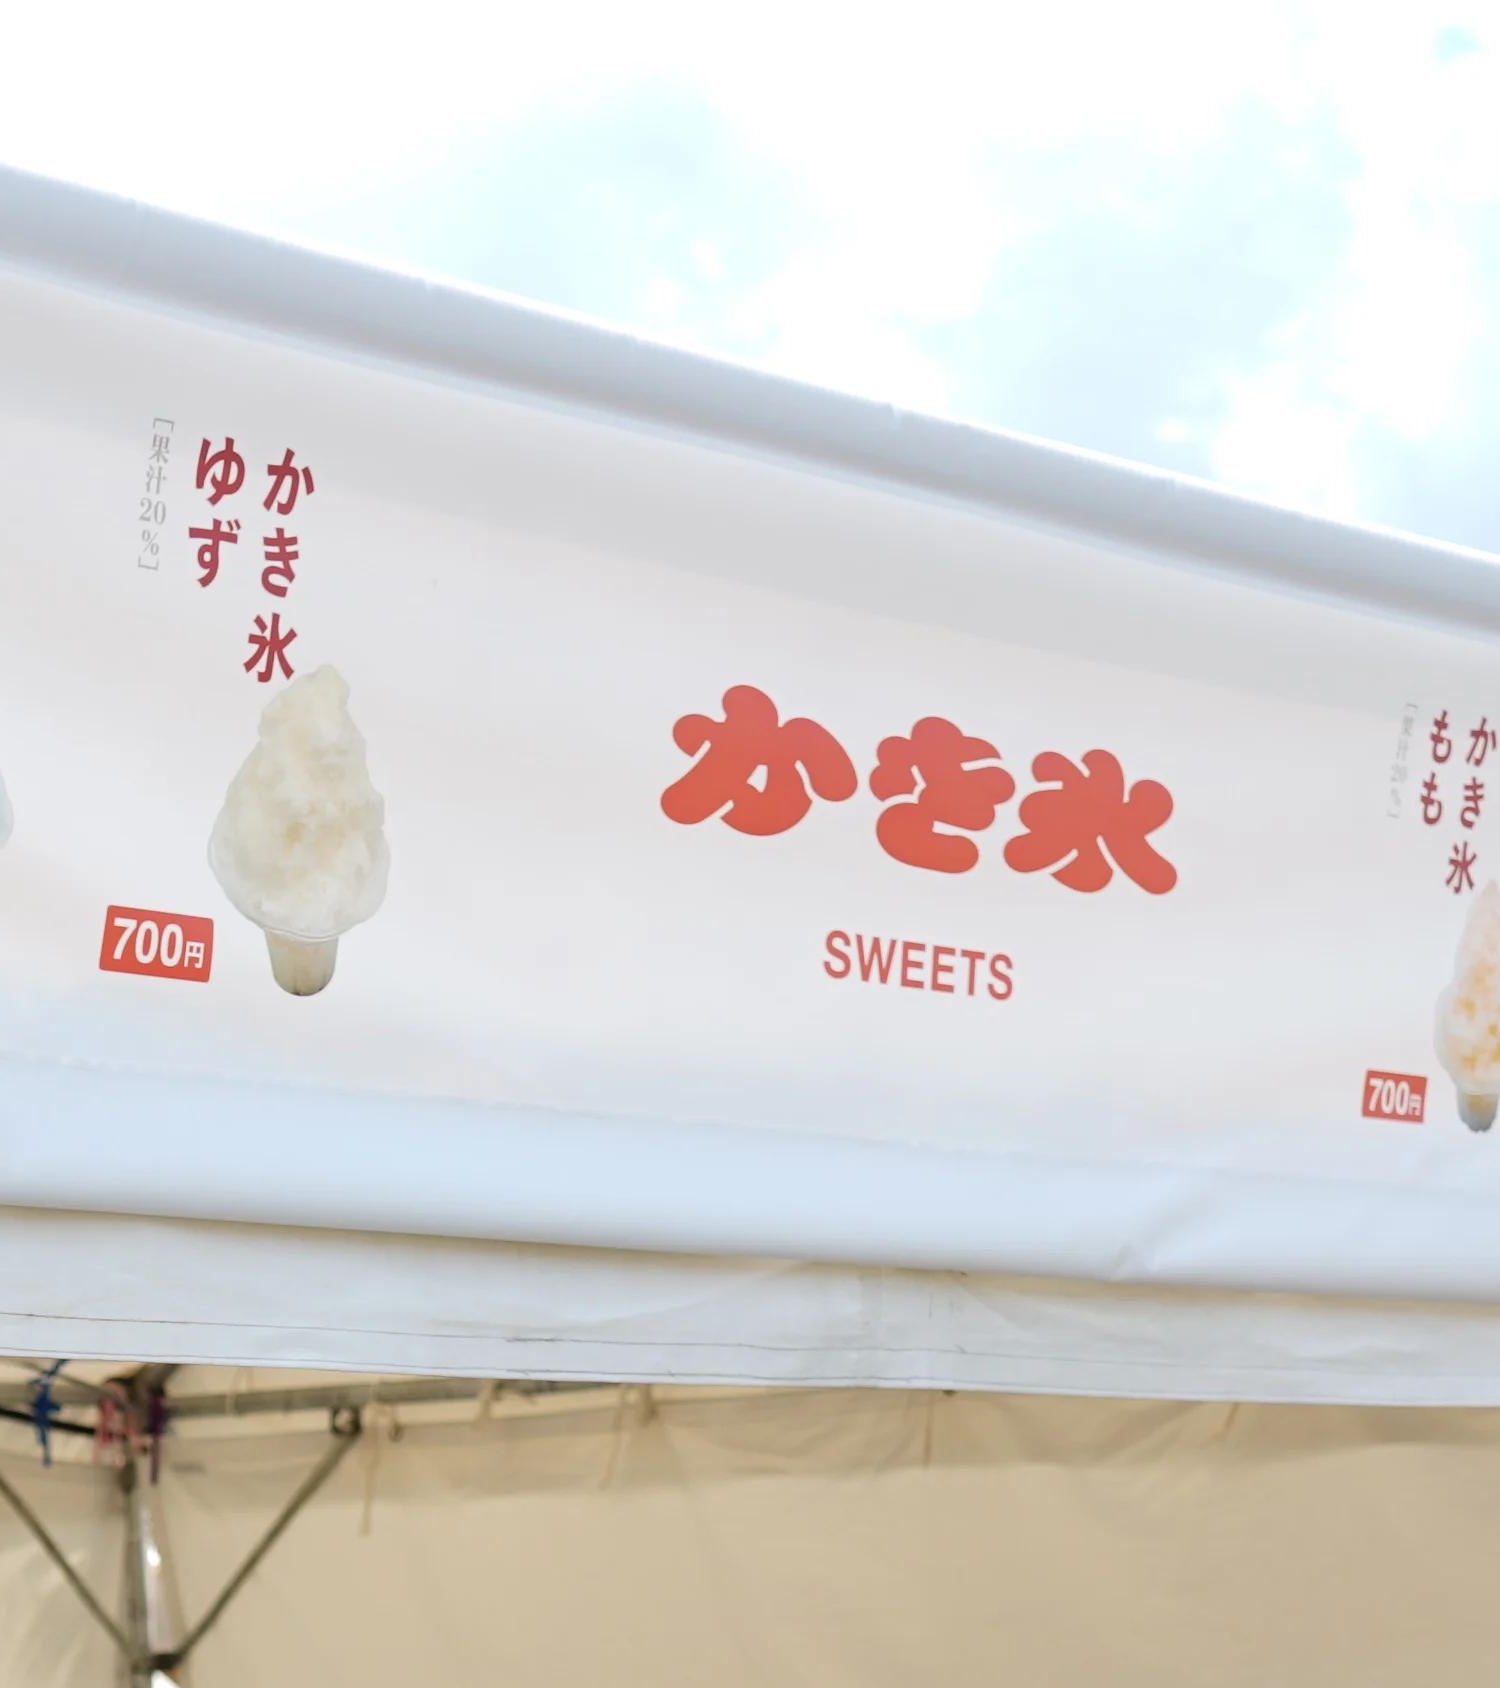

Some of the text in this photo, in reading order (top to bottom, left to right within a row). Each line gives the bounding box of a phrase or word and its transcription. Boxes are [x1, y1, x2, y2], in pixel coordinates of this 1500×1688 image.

[188, 436, 246, 588] ゆず
[243, 447, 314, 683] かき氷
[661, 685, 1177, 894] かき氷
[1420, 709, 1452, 824] もも
[1445, 717, 1497, 894] かき氷
[112, 918, 205, 969] 700円
[824, 930, 1014, 1000] SWEETS
[1369, 1078, 1421, 1116] 700円
